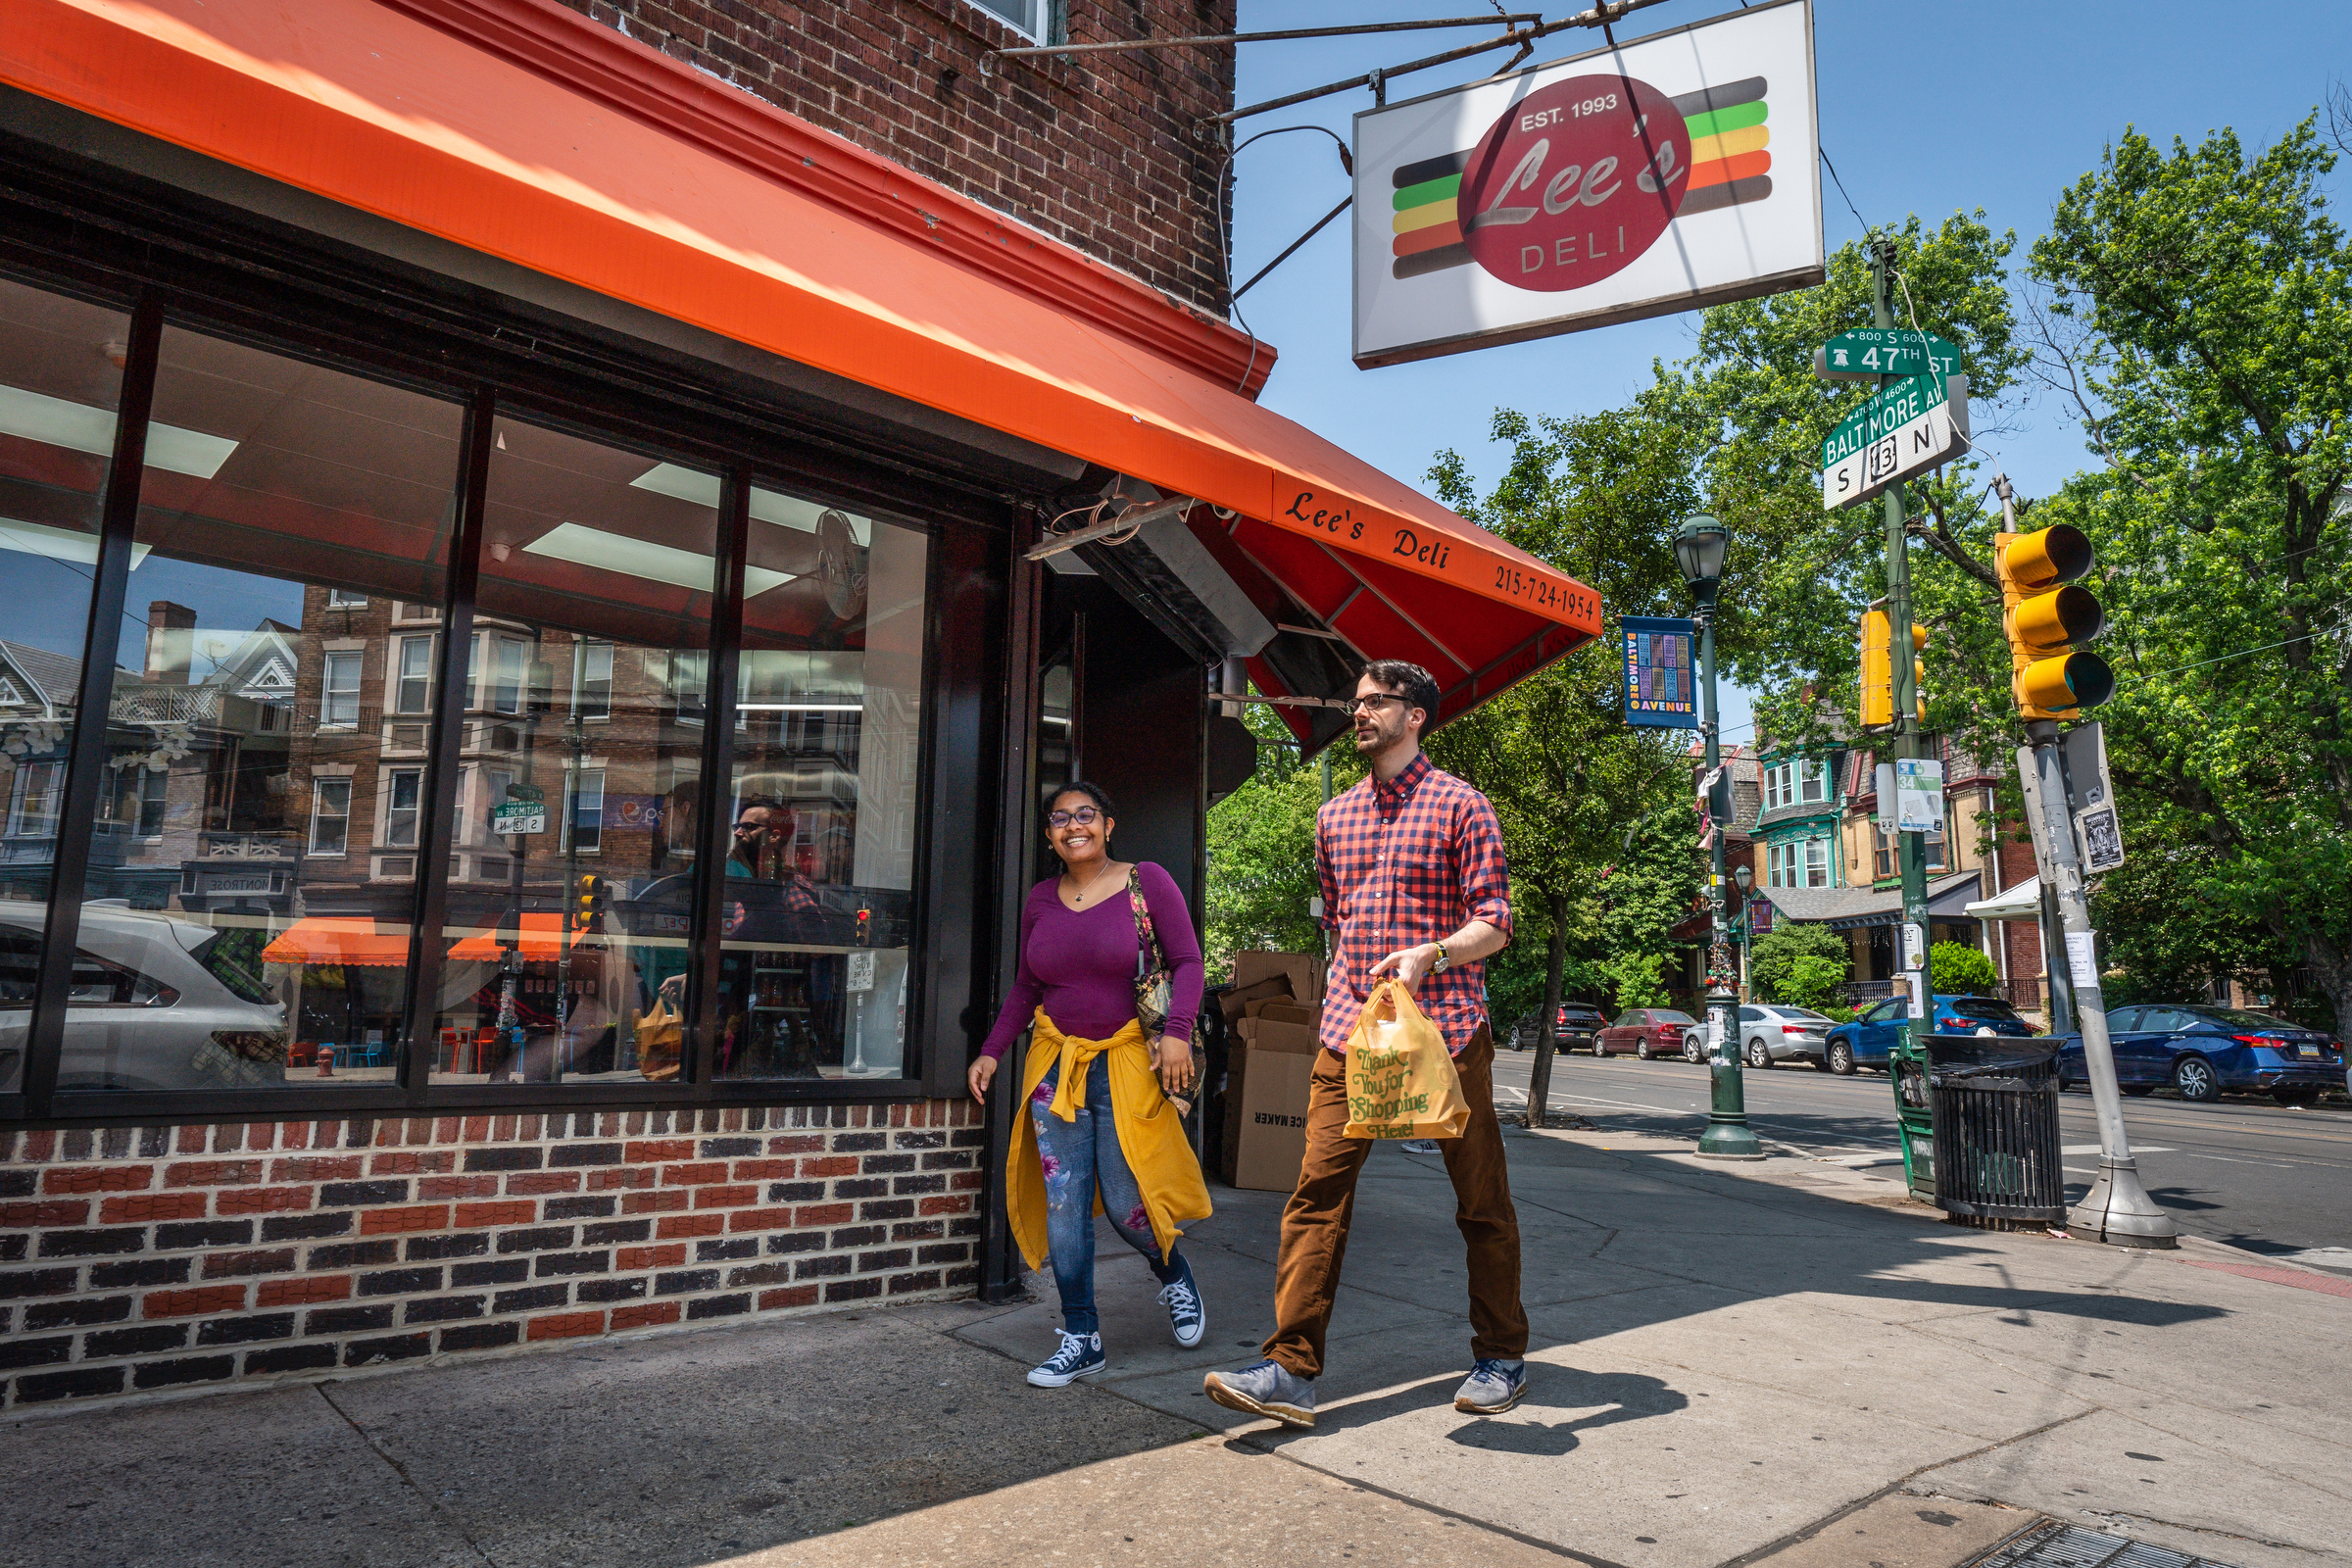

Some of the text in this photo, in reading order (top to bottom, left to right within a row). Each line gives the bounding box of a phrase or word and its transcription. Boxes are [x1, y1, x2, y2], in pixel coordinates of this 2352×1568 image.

[1521, 93, 1618, 132] EST. 1993
[1464, 113, 1686, 236] Lee's
[1521, 225, 1627, 274] DELI
[1859, 331, 1926, 344] 800 S 600
[1861, 347, 1953, 373] 47TH ST
[1853, 401, 1874, 419] 4700
[1885, 381, 1907, 400] 4600
[1826, 384, 1942, 466] BALTIMORE AV
[1838, 423, 1930, 493] S 13 N
[1285, 492, 1593, 621] Lee's Deli 215-724-1954
[1627, 632, 1640, 699] BALTIMORE
[1642, 701, 1691, 712] AVENUE
[1898, 776, 1915, 789] 34
[1356, 1045, 1409, 1076] Thank
[1352, 1069, 1413, 1099] You for
[1254, 1111, 1306, 1129] ICE MAKER
[1348, 1091, 1430, 1123] Shopping
[1367, 1119, 1415, 1140] Here!
